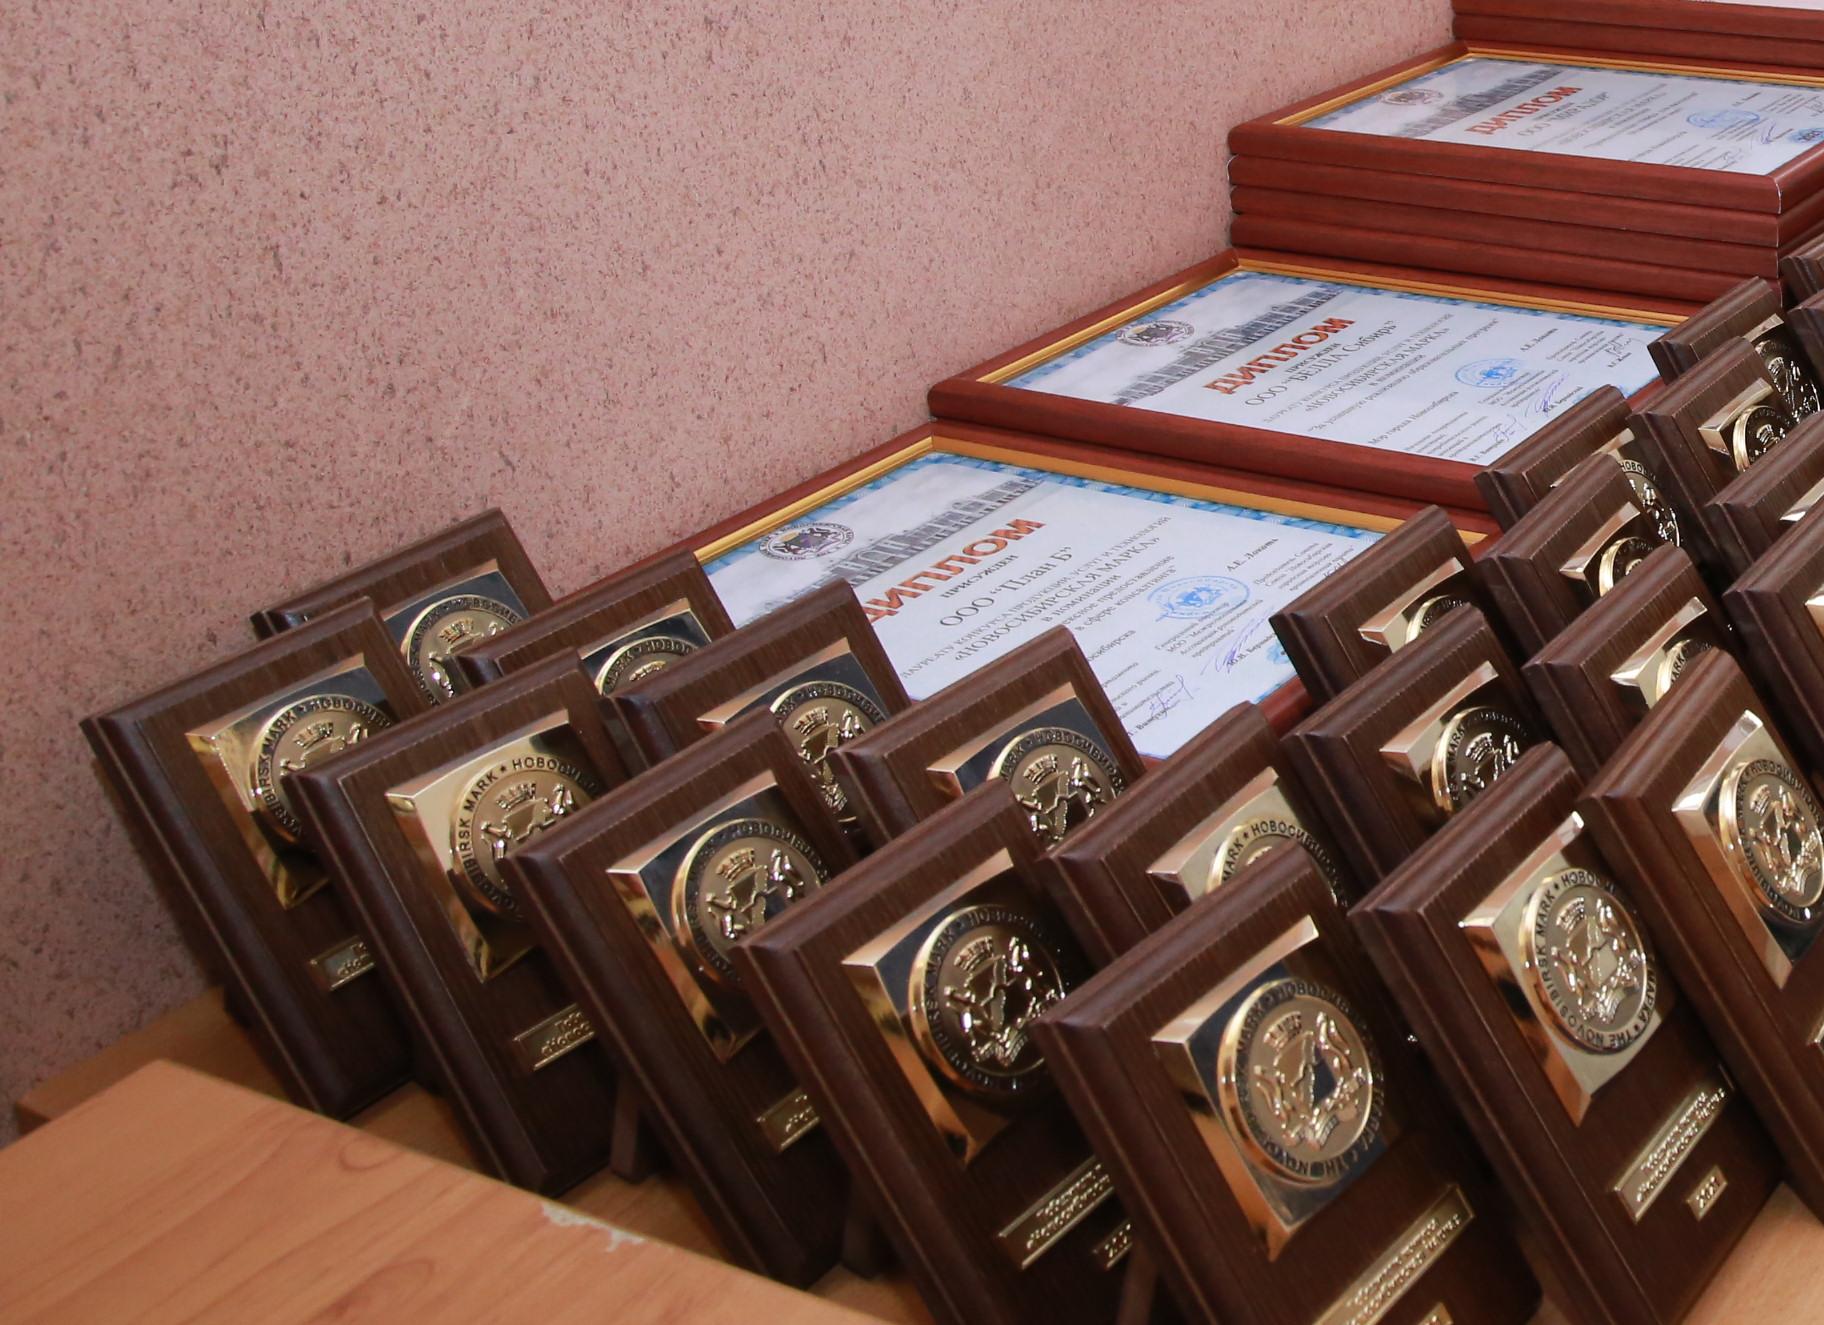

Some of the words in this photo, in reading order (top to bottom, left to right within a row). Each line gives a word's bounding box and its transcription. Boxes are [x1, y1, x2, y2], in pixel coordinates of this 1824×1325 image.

[1467, 86, 1582, 134] ДИПЛОМ
[1206, 318, 1354, 394] ДИПЛОМ
[1244, 385, 1288, 406] ООО
[1282, 354, 1348, 384] “БЕЛЛА
[1341, 320, 1399, 352] Сибирь”
[1306, 353, 1408, 411] «НОВОСИБИРСКАЯ
[1402, 328, 1450, 353] МАРКА»
[865, 517, 1047, 623] ДИПЛОМ
[939, 597, 995, 626] ООО
[990, 562, 1056, 594] “План
[1049, 546, 1078, 562] Б”
[940, 554, 1018, 598] ПРИСУЖДЕН
[1096, 555, 1175, 603] предоставление
[955, 572, 1101, 661] «НОВОСИБИРСКАЯ
[1096, 537, 1160, 572] МАРКА»
[1051, 574, 1121, 616] номинации
[1083, 606, 1116, 626] сфере
[953, 613, 1013, 645] КОНКУРСА
[263, 709, 298, 749] MARK
[462, 770, 499, 814] MARK
[1222, 837, 1245, 882] MARK
[1534, 888, 1556, 938] MARK
[1534, 945, 1605, 1048] NOVOSIBIRSK
[1608, 1025, 1634, 1048] THE
